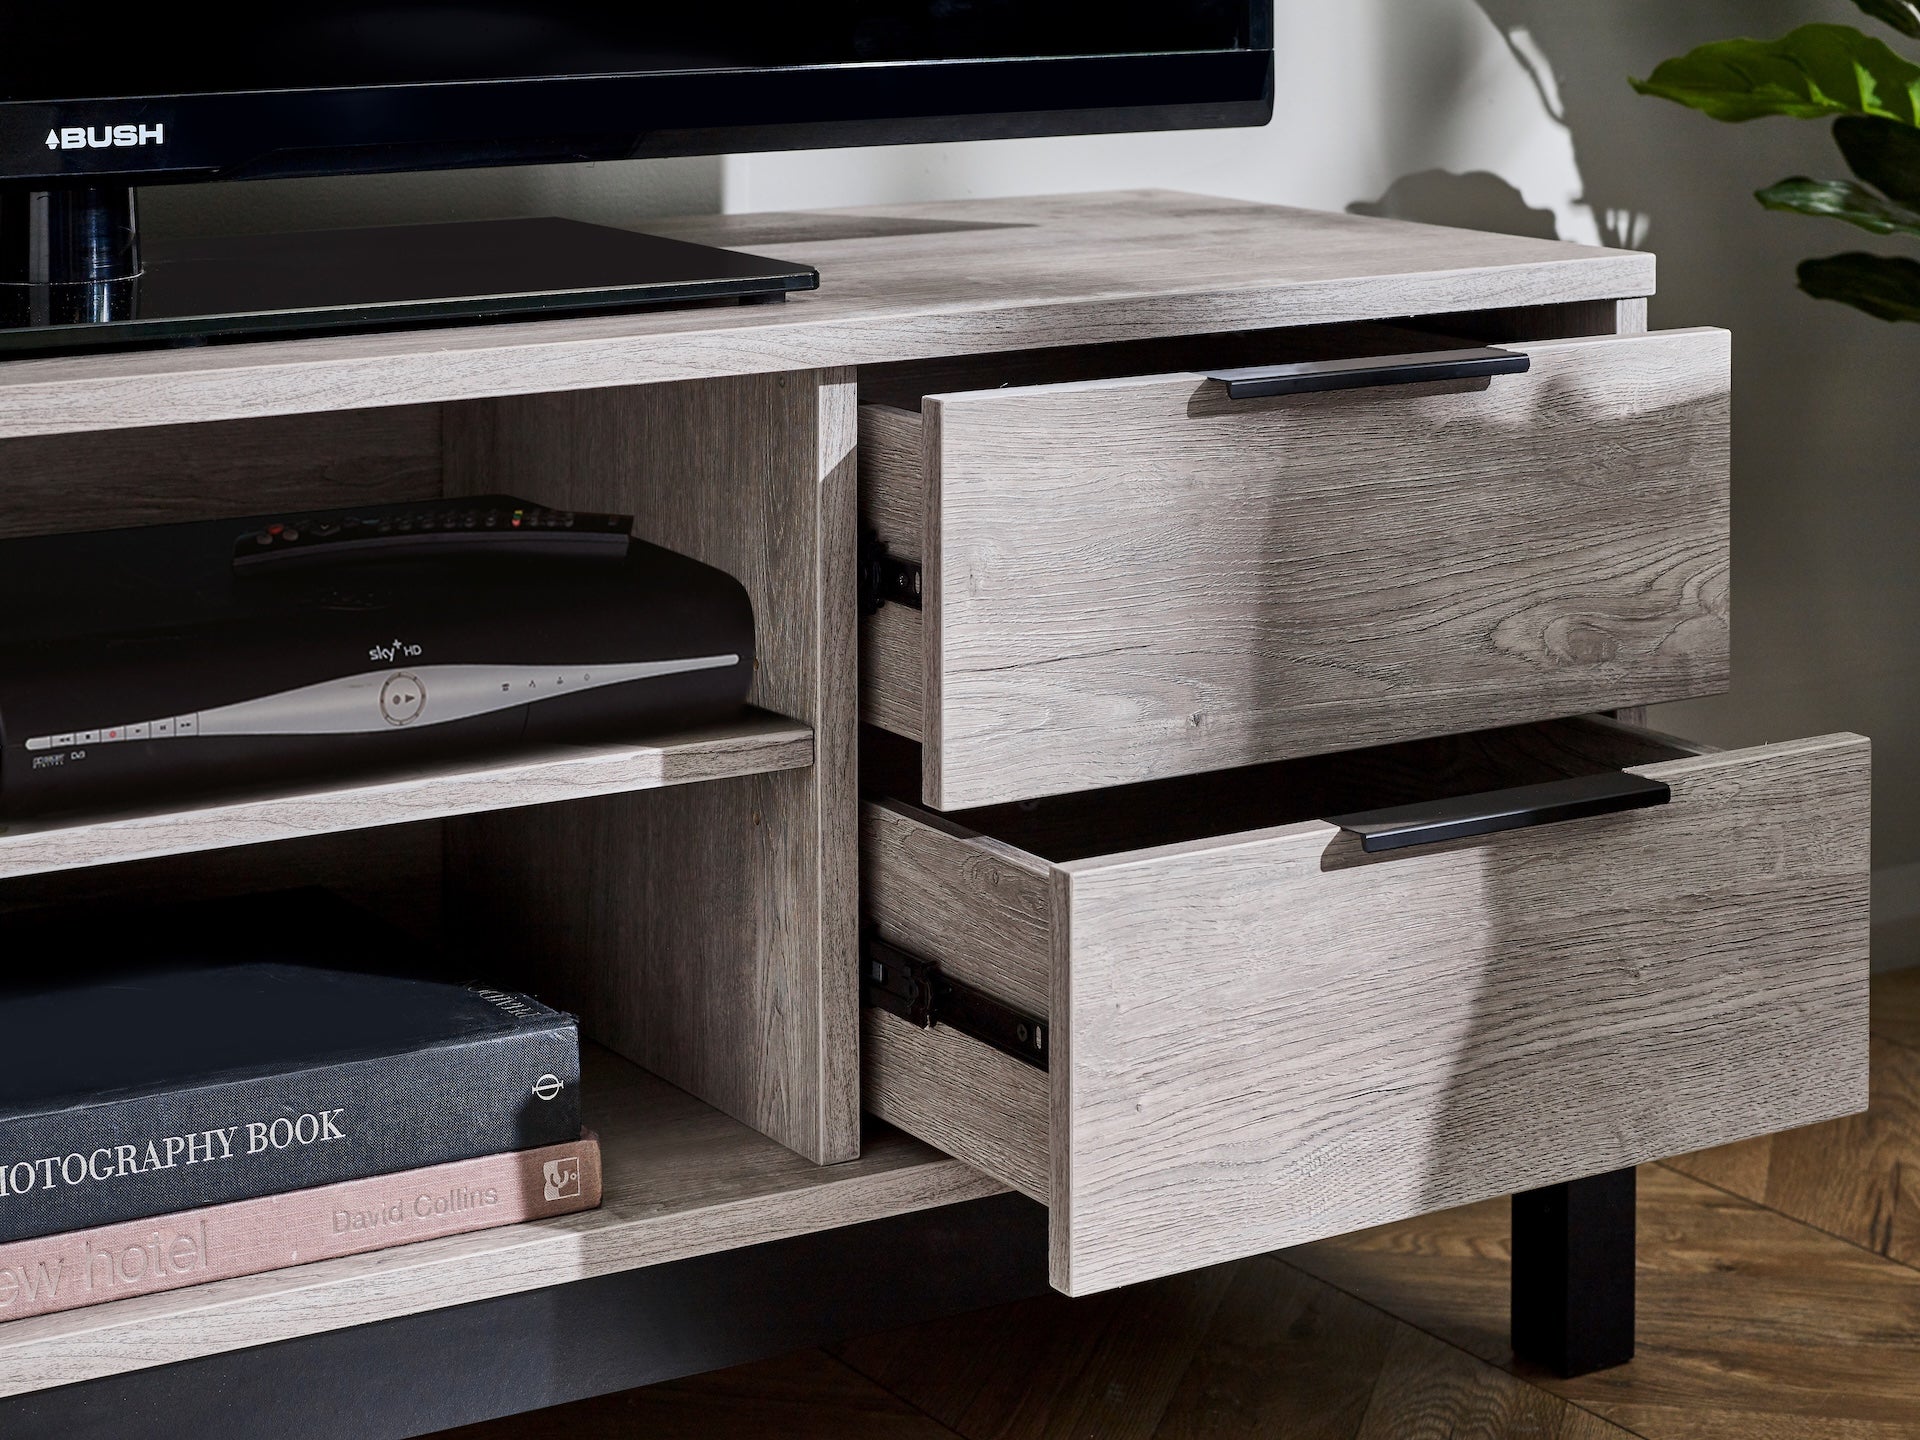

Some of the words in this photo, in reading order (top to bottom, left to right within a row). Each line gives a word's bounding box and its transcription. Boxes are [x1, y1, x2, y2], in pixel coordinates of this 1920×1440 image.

[61, 123, 164, 150] BUSH
[245, 1108, 347, 1154] BOOK
[332, 1199, 404, 1234] David
[413, 1186, 499, 1221] Collins
[85, 1219, 208, 1291] hotel
